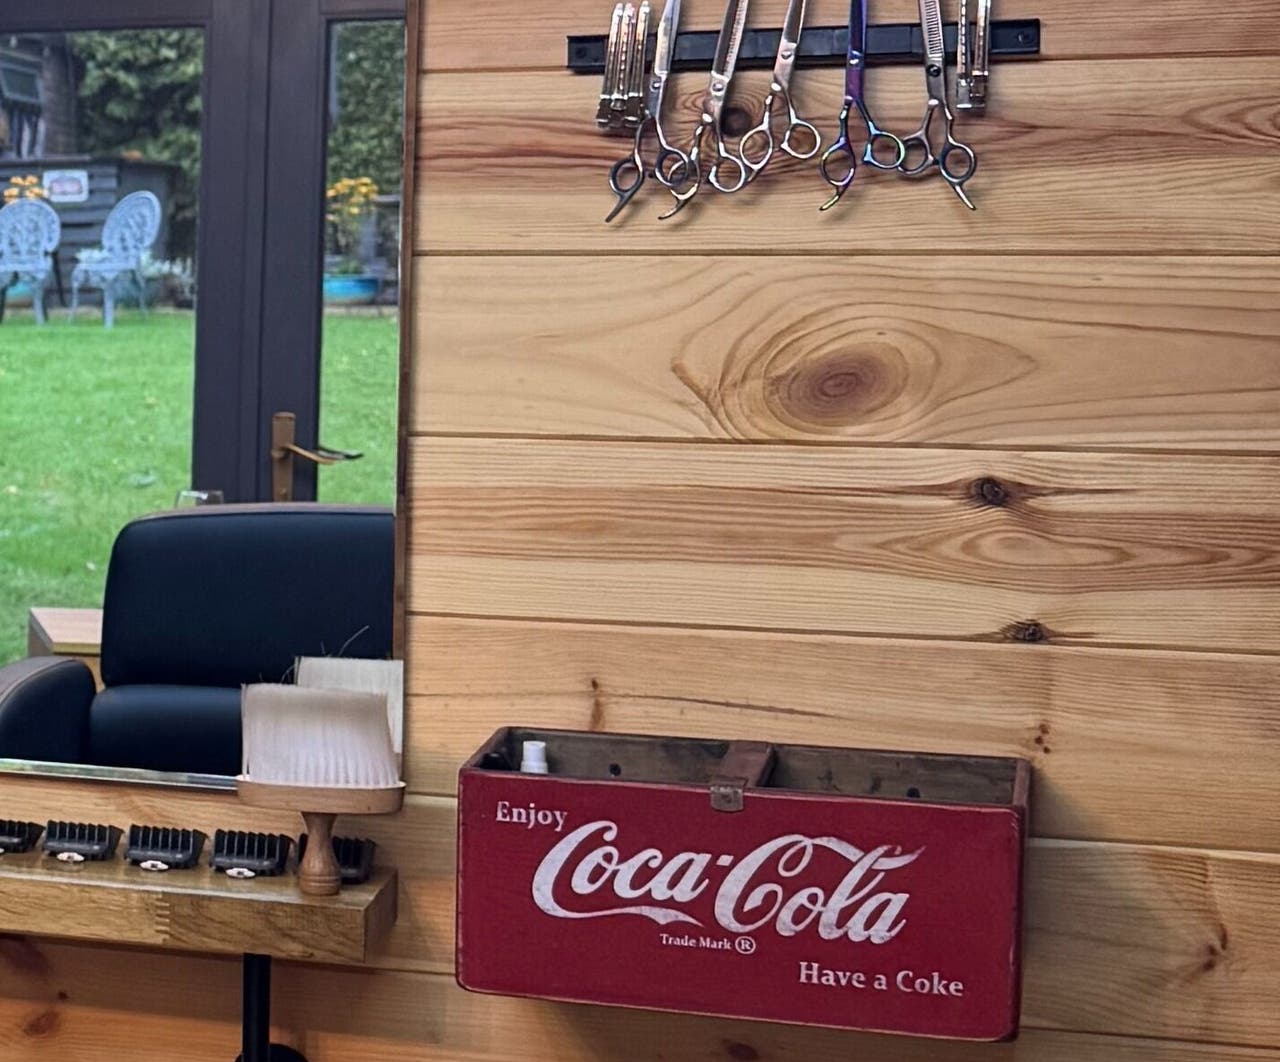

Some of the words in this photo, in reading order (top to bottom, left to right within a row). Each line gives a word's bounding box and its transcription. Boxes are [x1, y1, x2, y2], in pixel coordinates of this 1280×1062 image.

[496, 800, 568, 832] Enjoy
[532, 820, 926, 945] Coca-Cola
[659, 933, 697, 948] Trade
[699, 936, 732, 950] Mark
[799, 961, 867, 989] Have
[873, 974, 888, 990] a
[896, 970, 964, 997] Coke
